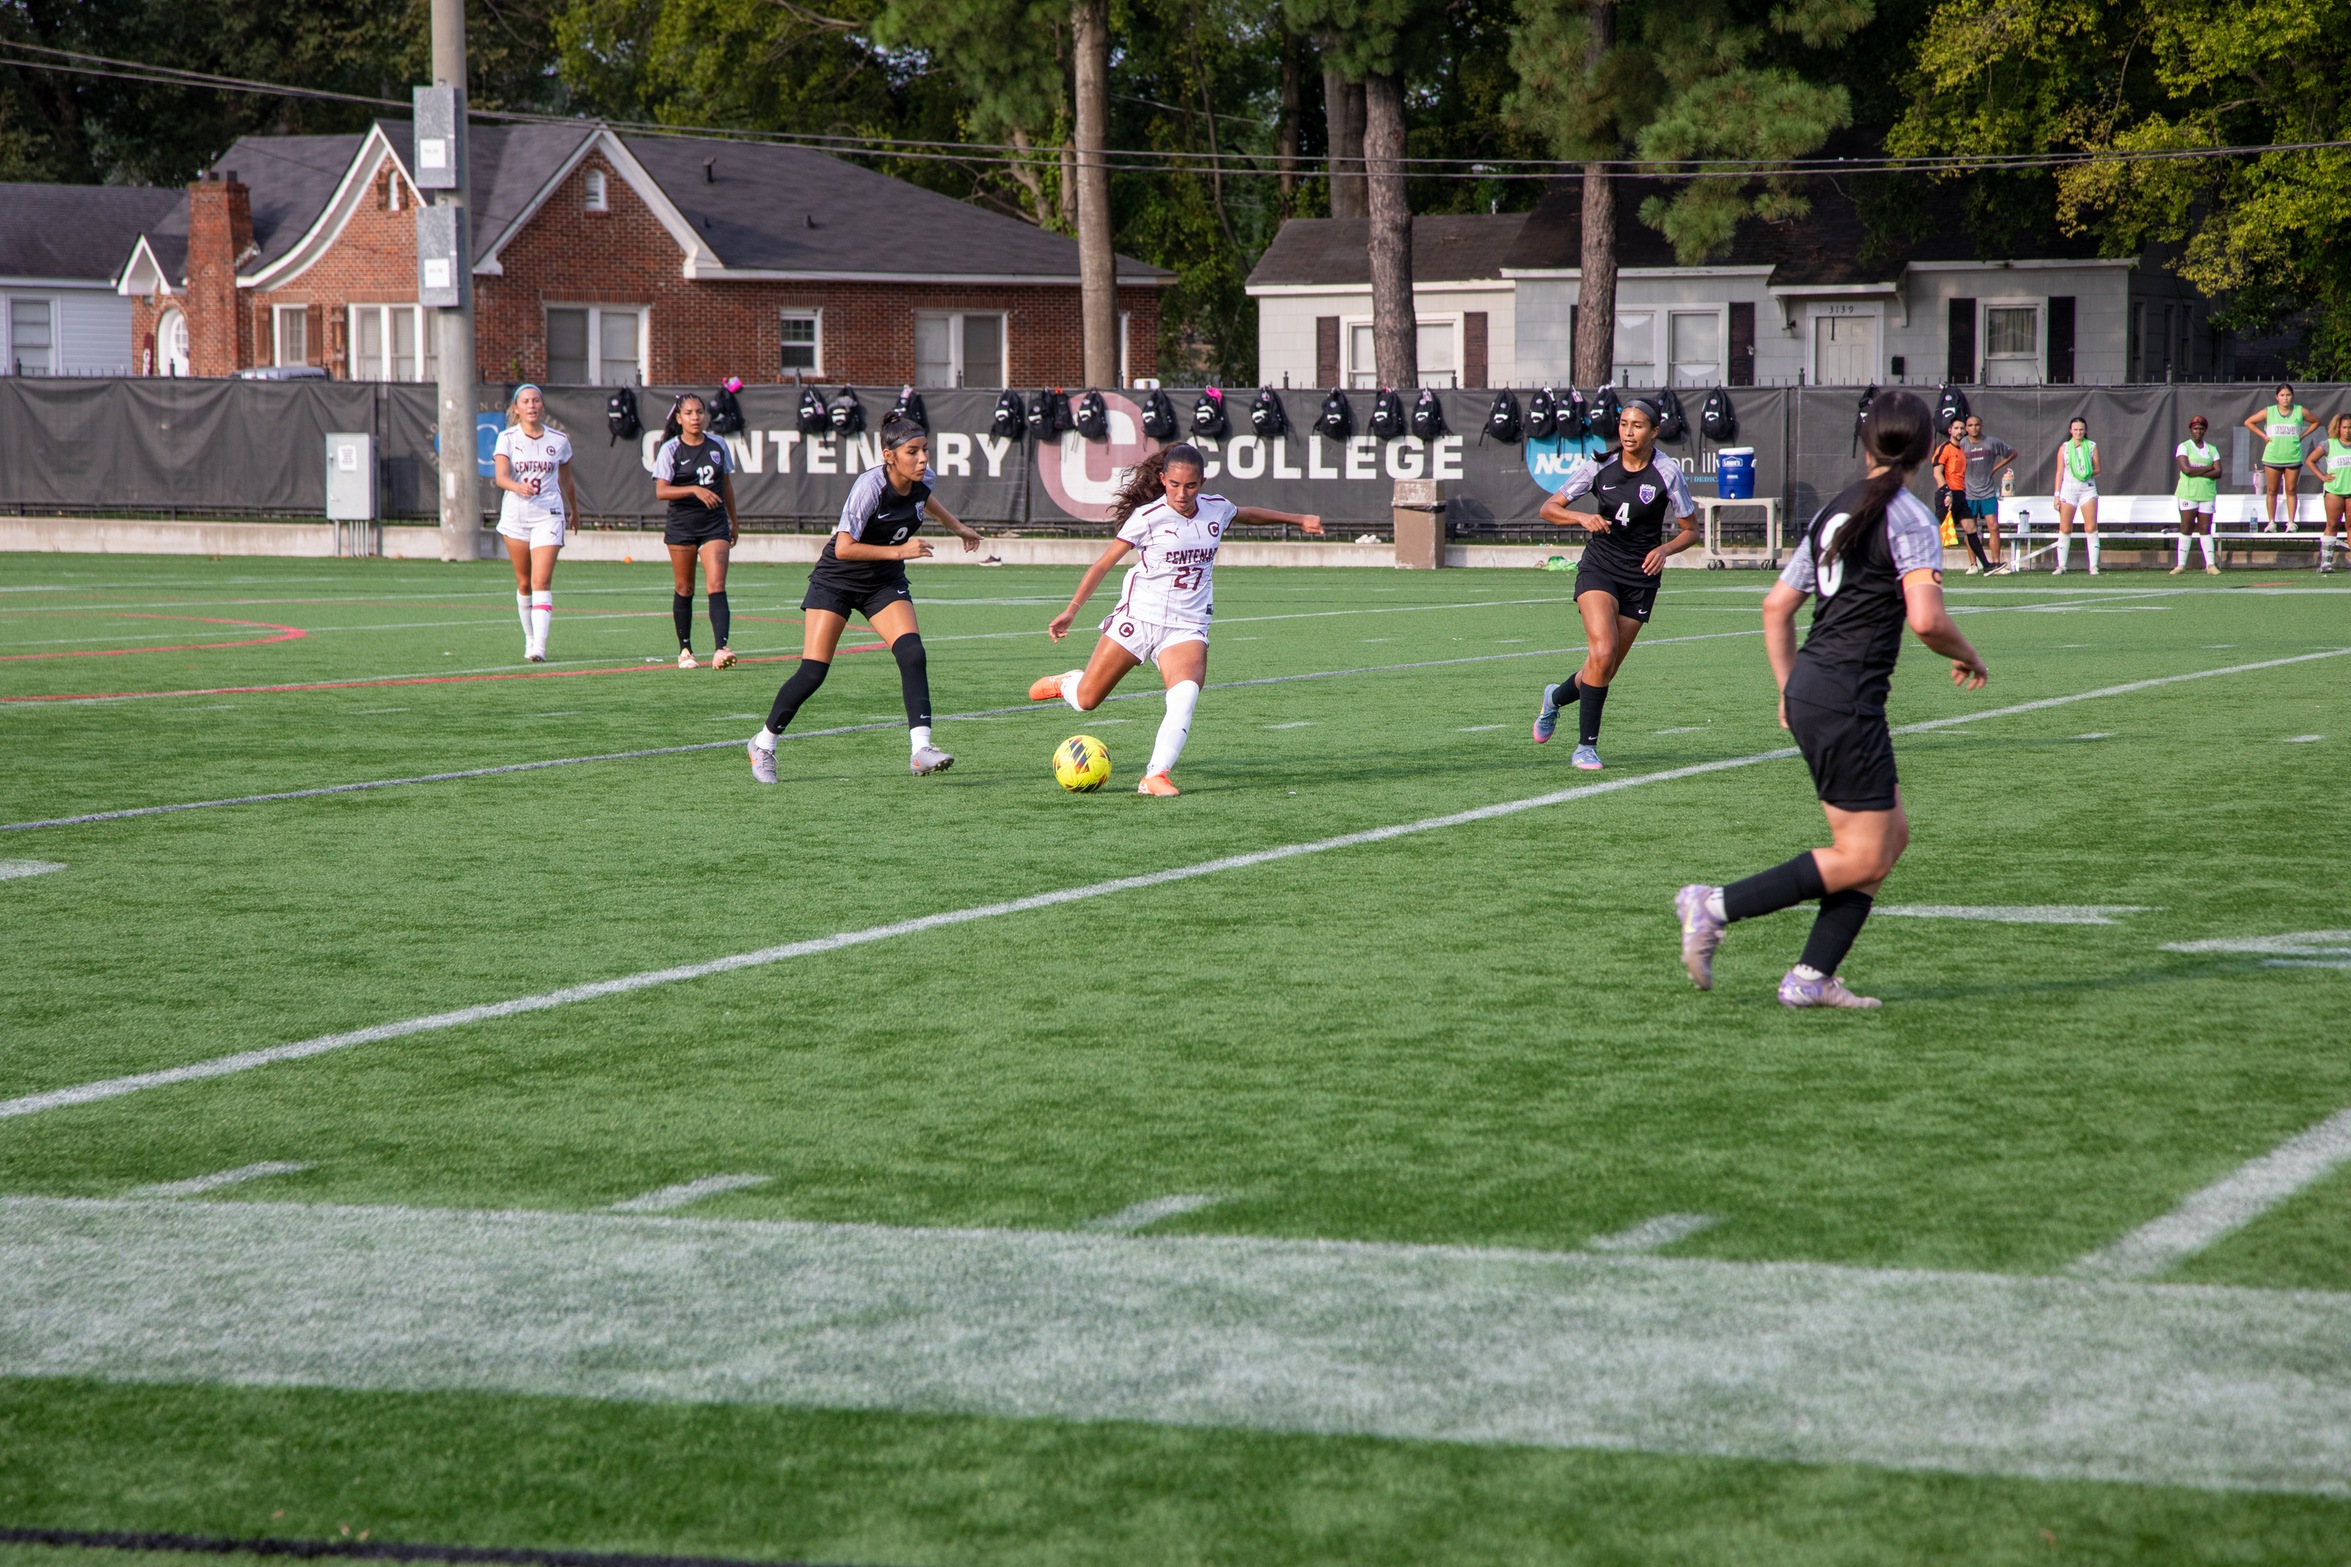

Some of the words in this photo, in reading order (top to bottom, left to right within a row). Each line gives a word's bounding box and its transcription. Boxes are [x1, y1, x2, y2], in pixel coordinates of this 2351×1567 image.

[1829, 305, 1854, 314] 3139
[642, 430, 1012, 477] CNTENRY
[1187, 435, 1463, 479] COLLEGE
[1534, 453, 1598, 474] NCA
[696, 465, 714, 485] 12
[1615, 502, 1630, 526] 4
[1174, 566, 1203, 591] 27
